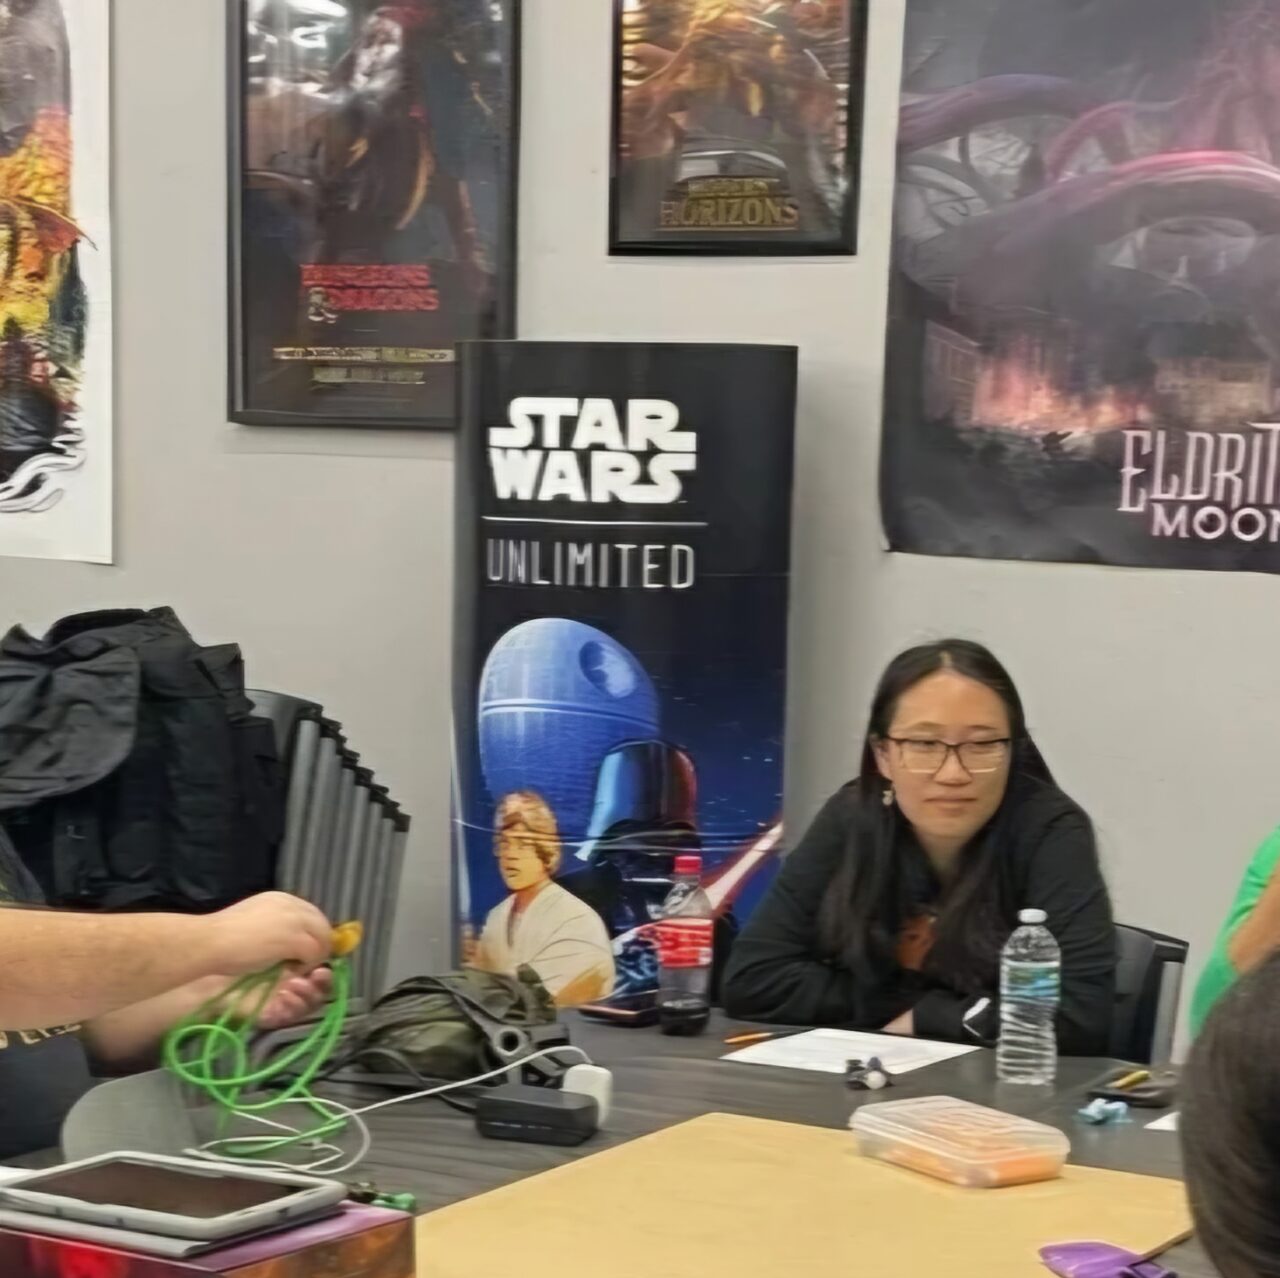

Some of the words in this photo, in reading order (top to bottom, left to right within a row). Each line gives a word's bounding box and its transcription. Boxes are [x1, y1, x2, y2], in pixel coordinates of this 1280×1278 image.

[487, 396, 697, 452] STAR
[487, 448, 697, 504] WARS
[486, 537, 695, 590] UNLIMITED
